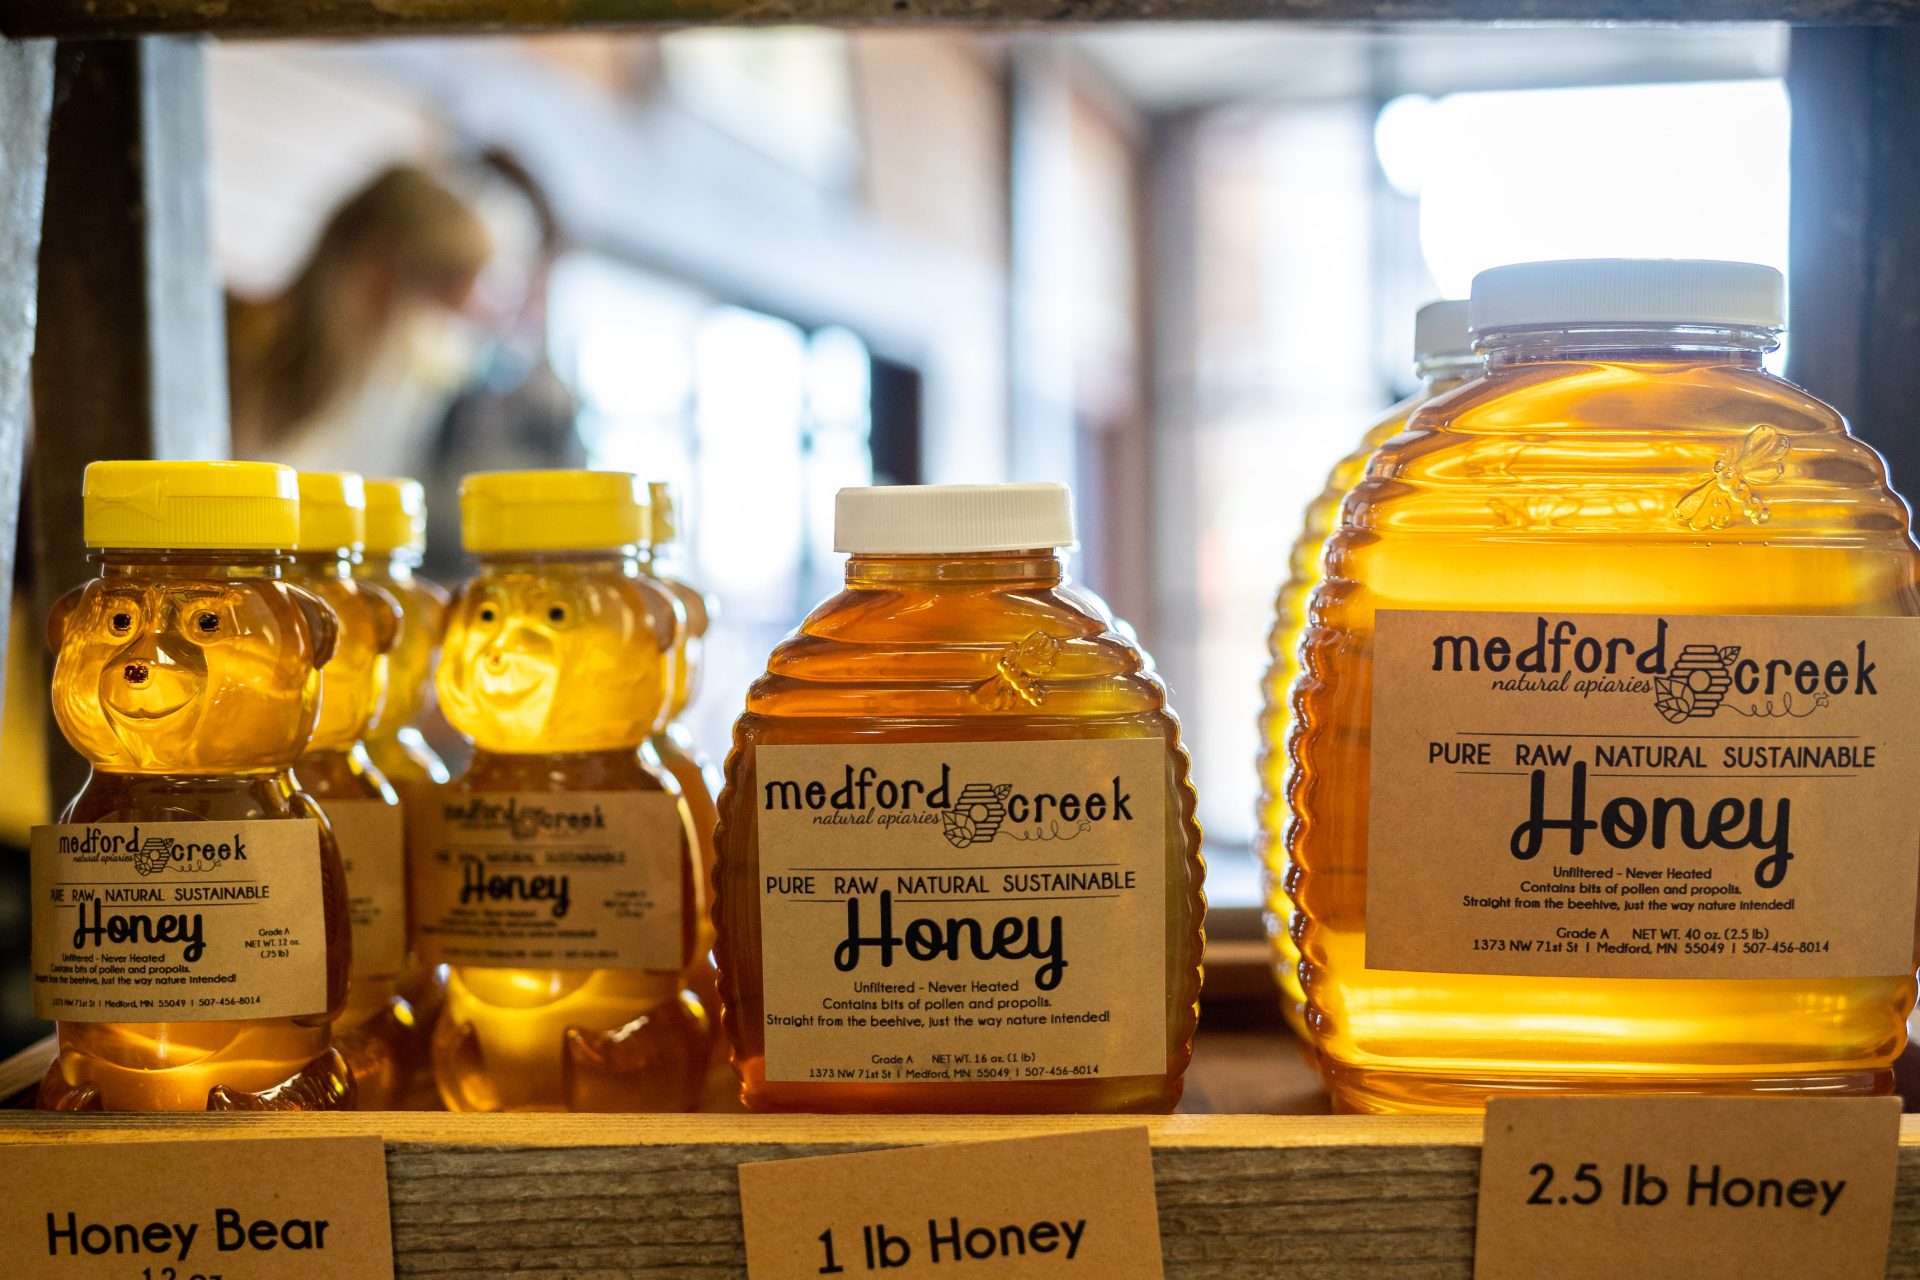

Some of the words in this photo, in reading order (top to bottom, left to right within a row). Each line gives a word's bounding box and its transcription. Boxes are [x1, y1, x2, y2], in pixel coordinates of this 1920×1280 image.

[1432, 617, 1670, 674] medford
[1734, 640, 1877, 695] creek
[1491, 671, 1571, 694] natural
[1573, 673, 1653, 698] apiaries
[1429, 742, 1491, 765] PURE
[1515, 745, 1572, 767] RAW
[1595, 745, 1707, 768] NATURAL
[1723, 746, 1876, 768] SUSTAINABLE
[765, 763, 951, 810] medford
[1007, 776, 1133, 823] creek
[813, 808, 873, 825] natural
[877, 810, 941, 830] apiaries
[1510, 761, 1794, 889] Honey
[59, 826, 140, 854] medford
[171, 834, 247, 861] creek
[73, 852, 100, 862] natural
[100, 853, 133, 865] apiaries
[1553, 867, 1613, 879] Unfiltered
[1626, 867, 1663, 879] Never
[1667, 868, 1711, 880] Heated
[460, 859, 570, 918] Honey
[766, 877, 815, 894] PURE
[835, 877, 878, 894] RAW
[897, 875, 989, 894] NATURAL
[1003, 871, 1136, 891] SUSTAINABLE
[1520, 881, 1575, 893] Contains
[1579, 882, 1601, 894] bits
[1605, 882, 1619, 894] of
[1621, 882, 1659, 897] pollen
[1663, 883, 1687, 895] and
[1690, 883, 1742, 898] propolis.
[72, 889, 95, 901] RAW
[105, 889, 165, 901] NATURAL
[175, 886, 270, 900] SUSTAINABLE
[1463, 895, 1511, 910] Straight
[1514, 897, 1541, 909] from
[1544, 897, 1564, 909] the
[1568, 898, 1620, 911] beehive,
[1624, 899, 1644, 911] just
[1648, 899, 1667, 911] the
[1670, 901, 1694, 913] way
[1698, 899, 1736, 911] nature
[1740, 898, 1795, 910] intended!
[73, 897, 206, 963] Honey
[258, 928, 283, 936] Grade
[284, 927, 290, 935] A
[1556, 928, 1597, 939] Grade
[1600, 928, 1610, 939] A
[1632, 929, 1657, 940] NET
[1660, 929, 1681, 940] WT.
[1684, 929, 1701, 940] 40
[1724, 928, 1749, 940] (2.5
[1752, 928, 1769, 940] lb)
[245, 940, 261, 948] NET
[834, 889, 1068, 991] Honey
[1473, 939, 1506, 951] 1373
[1510, 940, 1532, 952] NW
[1536, 940, 1562, 952] 71st
[1566, 941, 1578, 952] St
[1597, 941, 1652, 954] Medford,
[1656, 942, 1677, 953] MN
[1684, 942, 1724, 954] 55049
[1743, 941, 1829, 953] 507-456-8014
[62, 953, 94, 962] Unfiltered
[101, 954, 127, 963] Never
[129, 954, 165, 962] Heated
[278, 949, 289, 957] lb)
[74, 965, 87, 973] bits
[89, 965, 97, 973] of
[99, 965, 126, 975] pollen
[128, 965, 146, 974] and
[149, 965, 190, 975] propolis.
[69, 976, 99, 985] beehive,
[101, 976, 115, 985] just
[117, 976, 132, 985] the
[133, 978, 151, 986] way
[155, 975, 186, 984] nature
[190, 974, 237, 984] intended!
[854, 981, 914, 993] Unfiltered
[928, 981, 966, 993] Never
[971, 980, 1019, 992] Heated
[140, 1000, 153, 1008] MN
[158, 999, 186, 1007] 55049
[199, 996, 261, 1006] 507-456-8014
[823, 998, 877, 1010] Contains
[881, 998, 903, 1010] bits
[907, 998, 922, 1010] of
[924, 998, 965, 1013] pollen
[968, 997, 994, 1009] and
[997, 997, 1052, 1011] propolis.
[766, 1014, 814, 1029] Straight
[817, 1014, 843, 1027] from
[847, 1014, 866, 1027] the
[870, 1015, 924, 1028] beehive,
[929, 1016, 949, 1029] just
[953, 1015, 973, 1027] the
[977, 1017, 1003, 1029] way
[1006, 1014, 1047, 1026] nature
[1051, 1011, 1110, 1025] intended!
[872, 1055, 903, 1064] Grade
[906, 1055, 914, 1064] A
[932, 1054, 951, 1064] NET
[954, 1054, 972, 1064] WT.
[974, 1054, 987, 1063] 16
[1007, 1053, 1017, 1064] (1
[1021, 1052, 1036, 1063] lb)
[809, 1069, 835, 1078] 1373
[837, 1069, 856, 1078] NW
[858, 1068, 879, 1078] 71st
[881, 1069, 892, 1078] St
[906, 1068, 950, 1079] Medford,
[953, 1068, 971, 1077] MN
[977, 1068, 1009, 1077] 55049
[1025, 1065, 1099, 1077] 507-456-8014
[1528, 1162, 1603, 1205] 2.5
[1622, 1164, 1668, 1206] lb
[1688, 1165, 1847, 1215] Honey
[47, 1211, 198, 1261] Honey
[215, 1208, 330, 1252] Bear
[818, 1227, 844, 1274] 1
[863, 1224, 911, 1270] lb
[928, 1216, 1087, 1263] Honey
